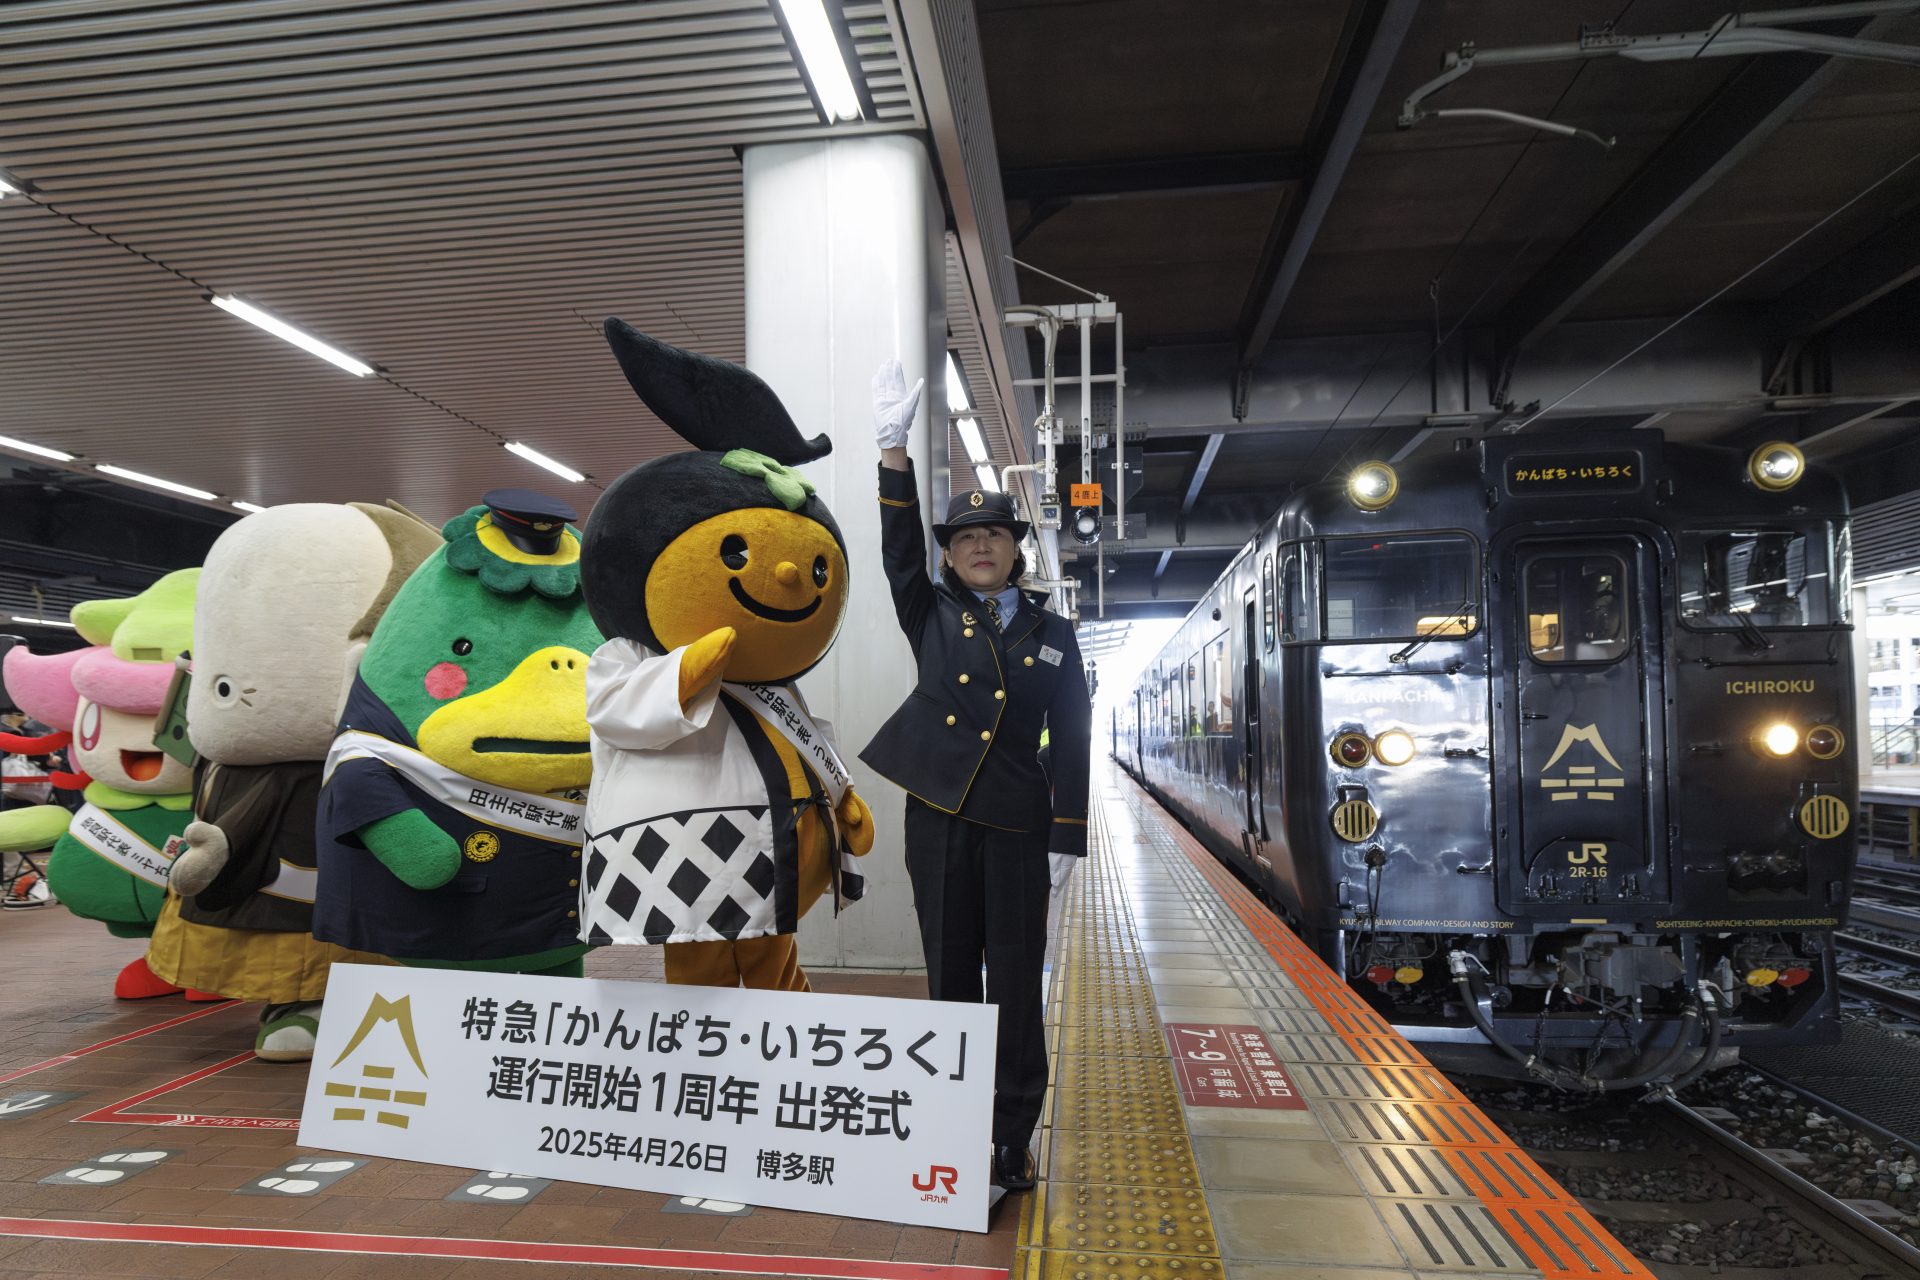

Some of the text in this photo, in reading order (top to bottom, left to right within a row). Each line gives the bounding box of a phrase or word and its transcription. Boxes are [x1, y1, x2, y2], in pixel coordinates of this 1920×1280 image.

[1726, 680, 1815, 694] ICHIROKU
[468, 788, 580, 831] 田主丸駅代表
[1568, 843, 1608, 864] JR
[1569, 866, 1608, 878] 2R-16
[1490, 921, 1514, 929] STORY
[461, 996, 968, 1082] 特急「かんぱち・いちろく」
[1260, 1070, 1293, 1097] 乗車口
[486, 1056, 912, 1141] 運行開始1周年 出発式
[537, 1126, 836, 1186] 2025年4月26日 博多駅
[912, 1165, 958, 1195] JR
[920, 1194, 949, 1204] JR九州
